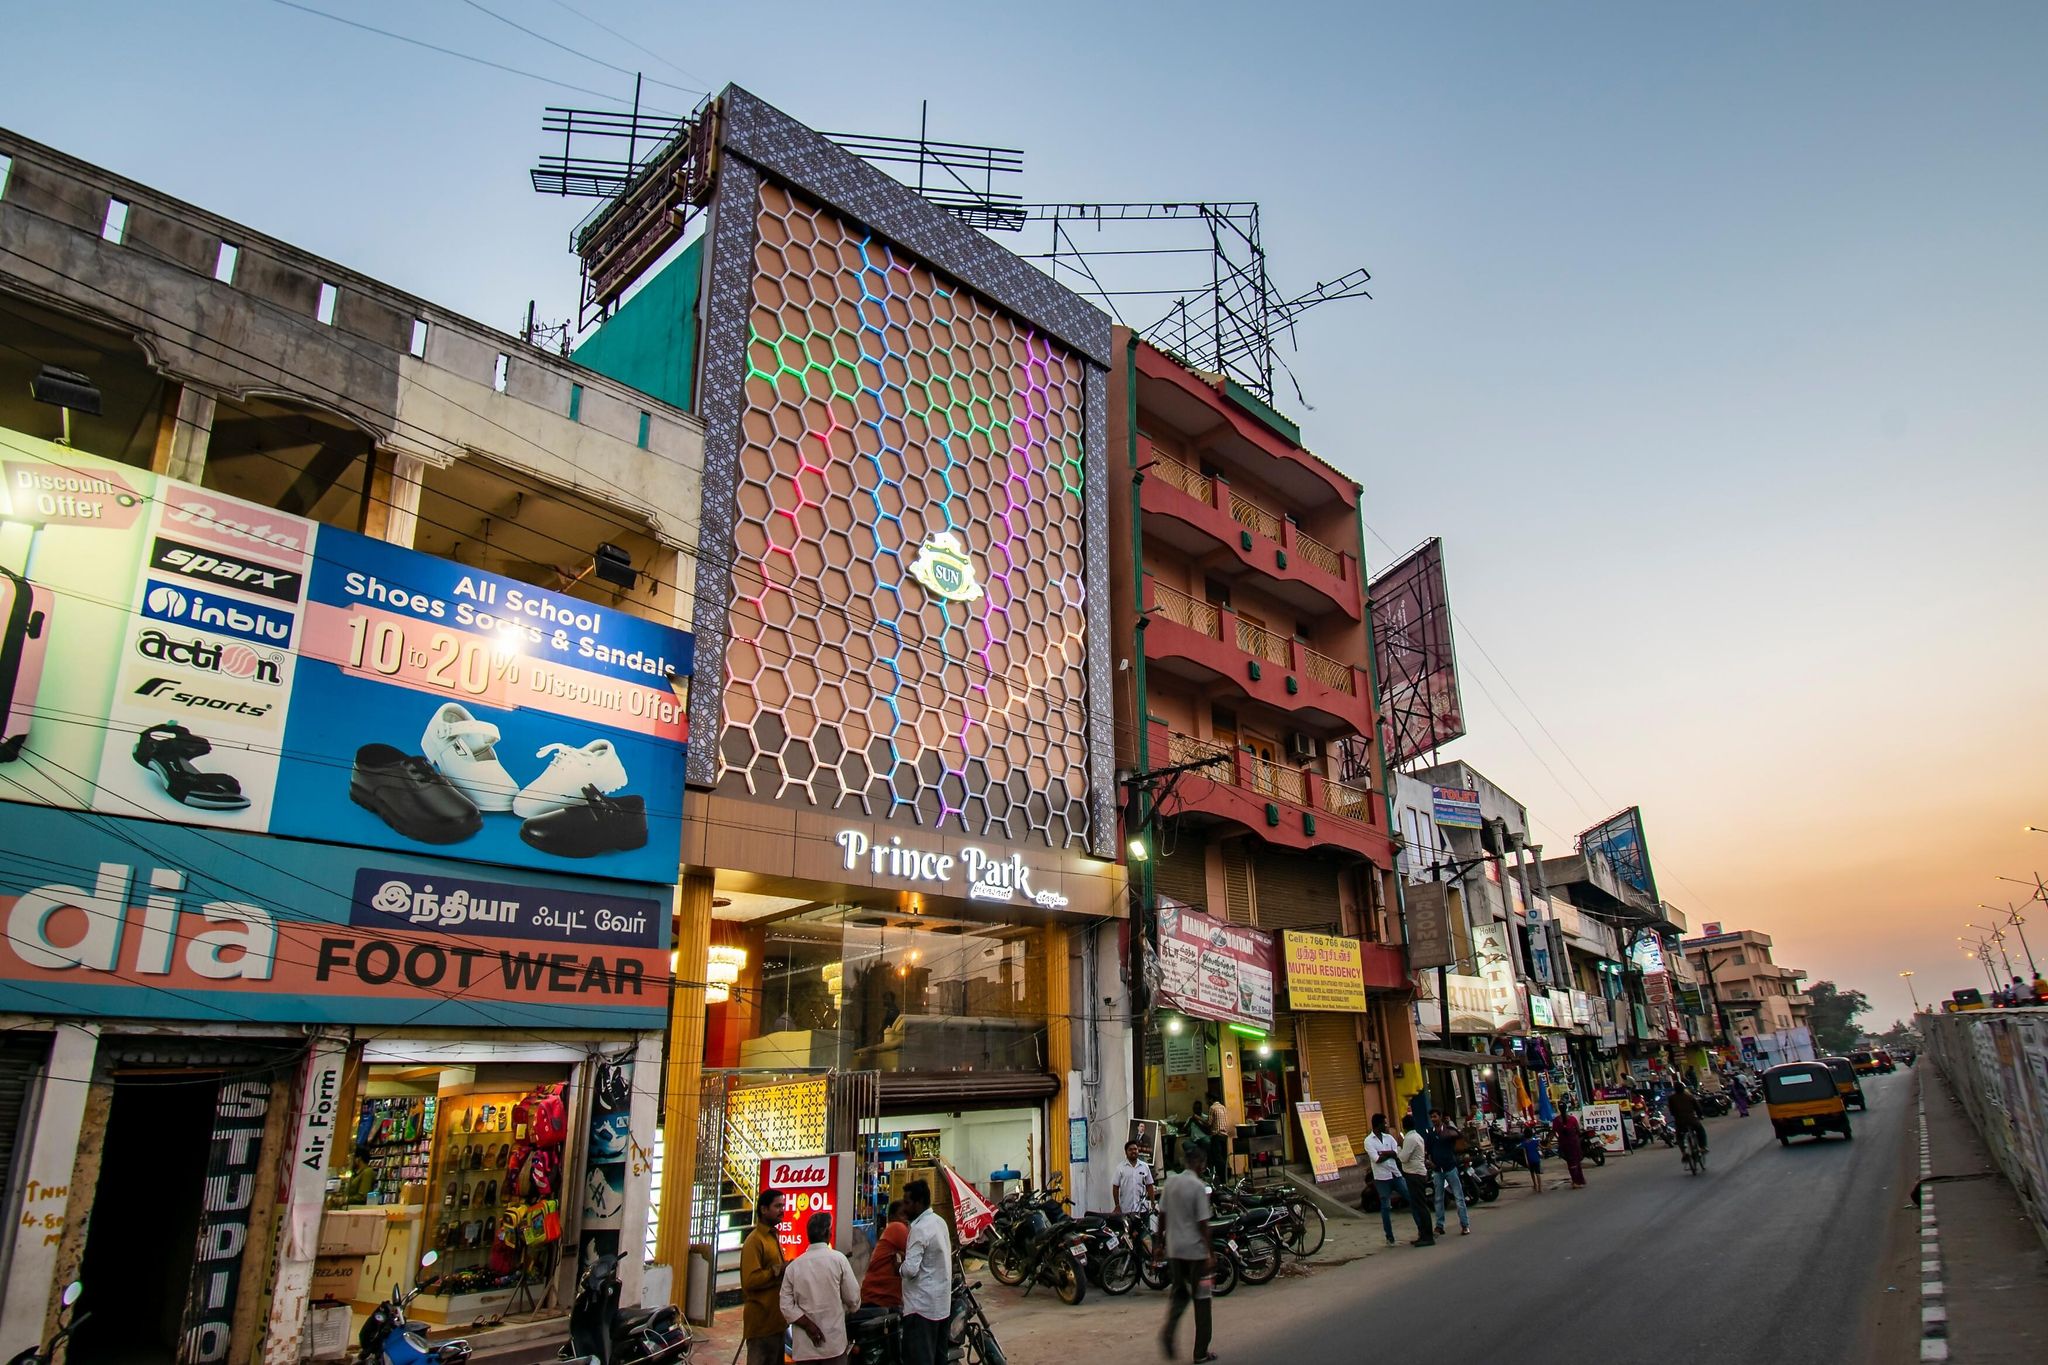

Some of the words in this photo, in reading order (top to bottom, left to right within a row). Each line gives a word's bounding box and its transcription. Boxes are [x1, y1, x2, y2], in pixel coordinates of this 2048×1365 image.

[16, 470, 115, 495] Discount
[37, 494, 104, 520] Offer
[167, 502, 300, 551] Bata
[161, 548, 293, 590] sparx
[935, 564, 959, 586] SUN
[190, 596, 290, 641] inblu
[453, 575, 496, 605] All
[505, 588, 602, 635] School
[344, 571, 446, 618] Shoes
[550, 628, 570, 652] &
[577, 637, 676, 677] Sandals
[347, 614, 406, 677] 10
[408, 644, 429, 670] to
[529, 667, 623, 712] Discount
[626, 686, 685, 726] Offer
[835, 829, 955, 882] Prince
[961, 846, 1036, 900] Park
[6, 861, 281, 981] dia
[371, 880, 520, 927] இந்தியா
[594, 908, 648, 935] வேர்
[1288, 933, 1303, 943] Cell
[1479, 925, 1497, 937] Hotel
[315, 936, 485, 990] FOOT
[500, 950, 646, 996] WEAR
[1288, 961, 1318, 975] MUTHU
[1319, 964, 1361, 979] RESIDENCY
[1449, 985, 1489, 1013] RTHY
[308, 1069, 337, 1128] Form
[1585, 1116, 1618, 1126] TIFFIN
[1590, 1109, 1613, 1118] ARTHY
[302, 1135, 326, 1171] Air
[870, 1136, 899, 1148] TECNO
[1310, 1119, 1328, 1162] ROOMS
[772, 1164, 826, 1184] Bata
[40, 1186, 68, 1201] NH
[782, 1192, 833, 1212] HOOL
[188, 1081, 272, 1365] STUDIO
[776, 1221, 792, 1232] OES
[314, 1267, 353, 1277] RELAXO
